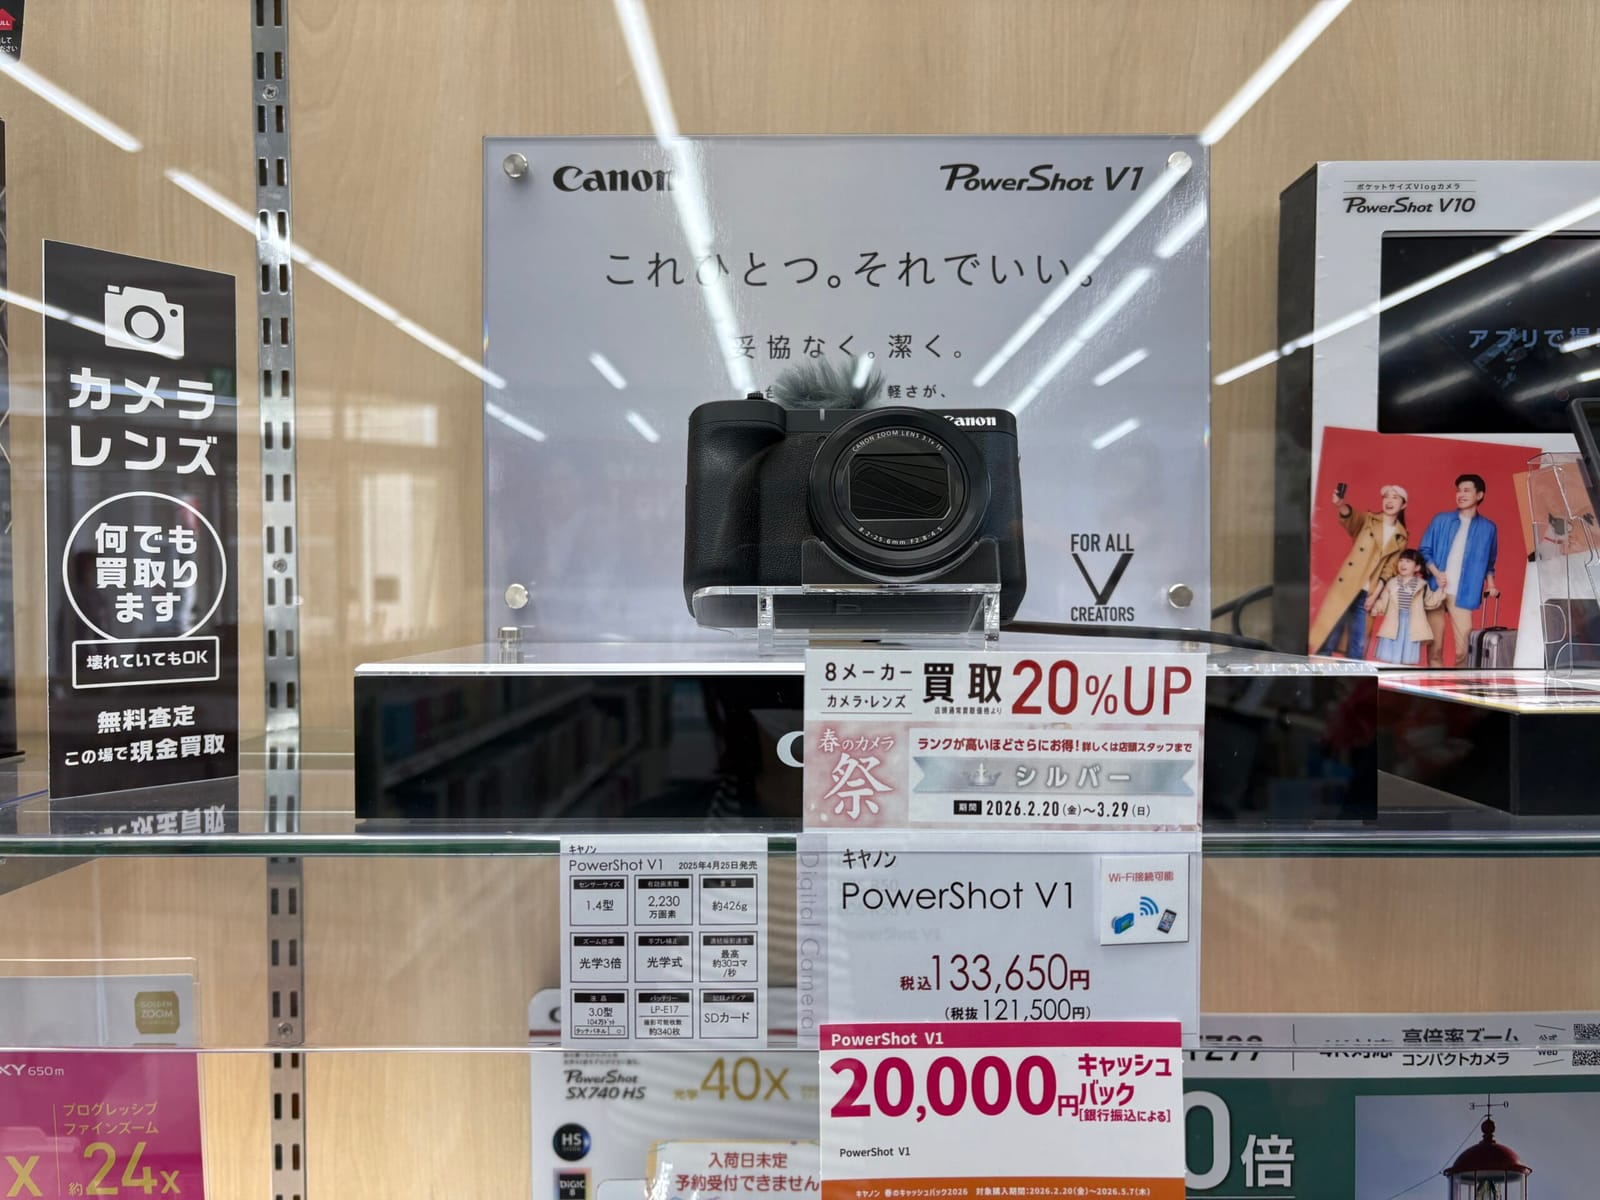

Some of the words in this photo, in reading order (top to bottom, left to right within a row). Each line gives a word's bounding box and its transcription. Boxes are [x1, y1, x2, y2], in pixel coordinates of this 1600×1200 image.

[940, 163, 1094, 191] PowerShot
[1105, 166, 1144, 191] V1
[1343, 197, 1433, 213] PowerShot
[1439, 197, 1476, 213] V10
[68, 367, 216, 421] カメラ
[852, 434, 875, 452] CANON
[877, 429, 899, 439] ZOOM
[901, 430, 920, 439] LENS
[70, 425, 218, 476] レンズ
[95, 522, 197, 554] 何でも
[1071, 533, 1100, 552] FOR
[1105, 533, 1135, 552] ALL
[96, 557, 198, 589] 買取り
[115, 592, 181, 623] ます
[1071, 606, 1135, 622] CREATORS
[86, 650, 208, 670] 壊れていてもOK
[825, 662, 912, 681] 8メーカー
[922, 663, 1002, 704] 買取
[1011, 659, 1192, 716] 20%UP
[827, 694, 906, 709] カメラ・レンズ
[97, 705, 195, 734] 無料査定
[818, 728, 895, 753] 春のカメラ
[64, 734, 225, 766] この場で現金買取
[1015, 765, 1132, 788] シルバー
[824, 752, 894, 820] 祭
[569, 859, 642, 871] PowerShot
[647, 859, 663, 871] V1
[678, 861, 758, 870] 2025年4月25日発売
[648, 895, 680, 908] 2,230
[842, 882, 1023, 910] PowerShot
[1035, 882, 1072, 909] V1
[586, 899, 614, 911] 1.4型
[712, 901, 748, 912] 約426g
[579, 957, 622, 970] 光学3倍
[647, 956, 683, 969] 光学式
[588, 1007, 613, 1018] 3.0型
[650, 1005, 679, 1014] LP-E17
[704, 1012, 751, 1024] SDカード
[831, 1032, 917, 1046] PowerShot
[924, 1031, 944, 1045] V1
[1078, 1053, 1172, 1077] キャッシュ
[1402, 1052, 1510, 1067] コンパクトカメラ
[28, 1066, 64, 1077] 650m
[564, 1069, 638, 1084] PowerShot
[565, 1086, 620, 1100] SX740
[623, 1086, 646, 1099] HS
[830, 1055, 1079, 1122] 20,000円
[1080, 1080, 1135, 1106] バック
[63, 1103, 158, 1116] プログレッシブ
[1079, 1108, 1171, 1123] [銀行振込による]
[63, 1122, 159, 1135] ファインズーム
[561, 1133, 582, 1146] HS
[708, 1152, 788, 1169] 入荷日未定
[839, 1147, 894, 1158] PowerShot
[899, 1147, 911, 1156] V1
[675, 1174, 819, 1192] 予約受付できません
